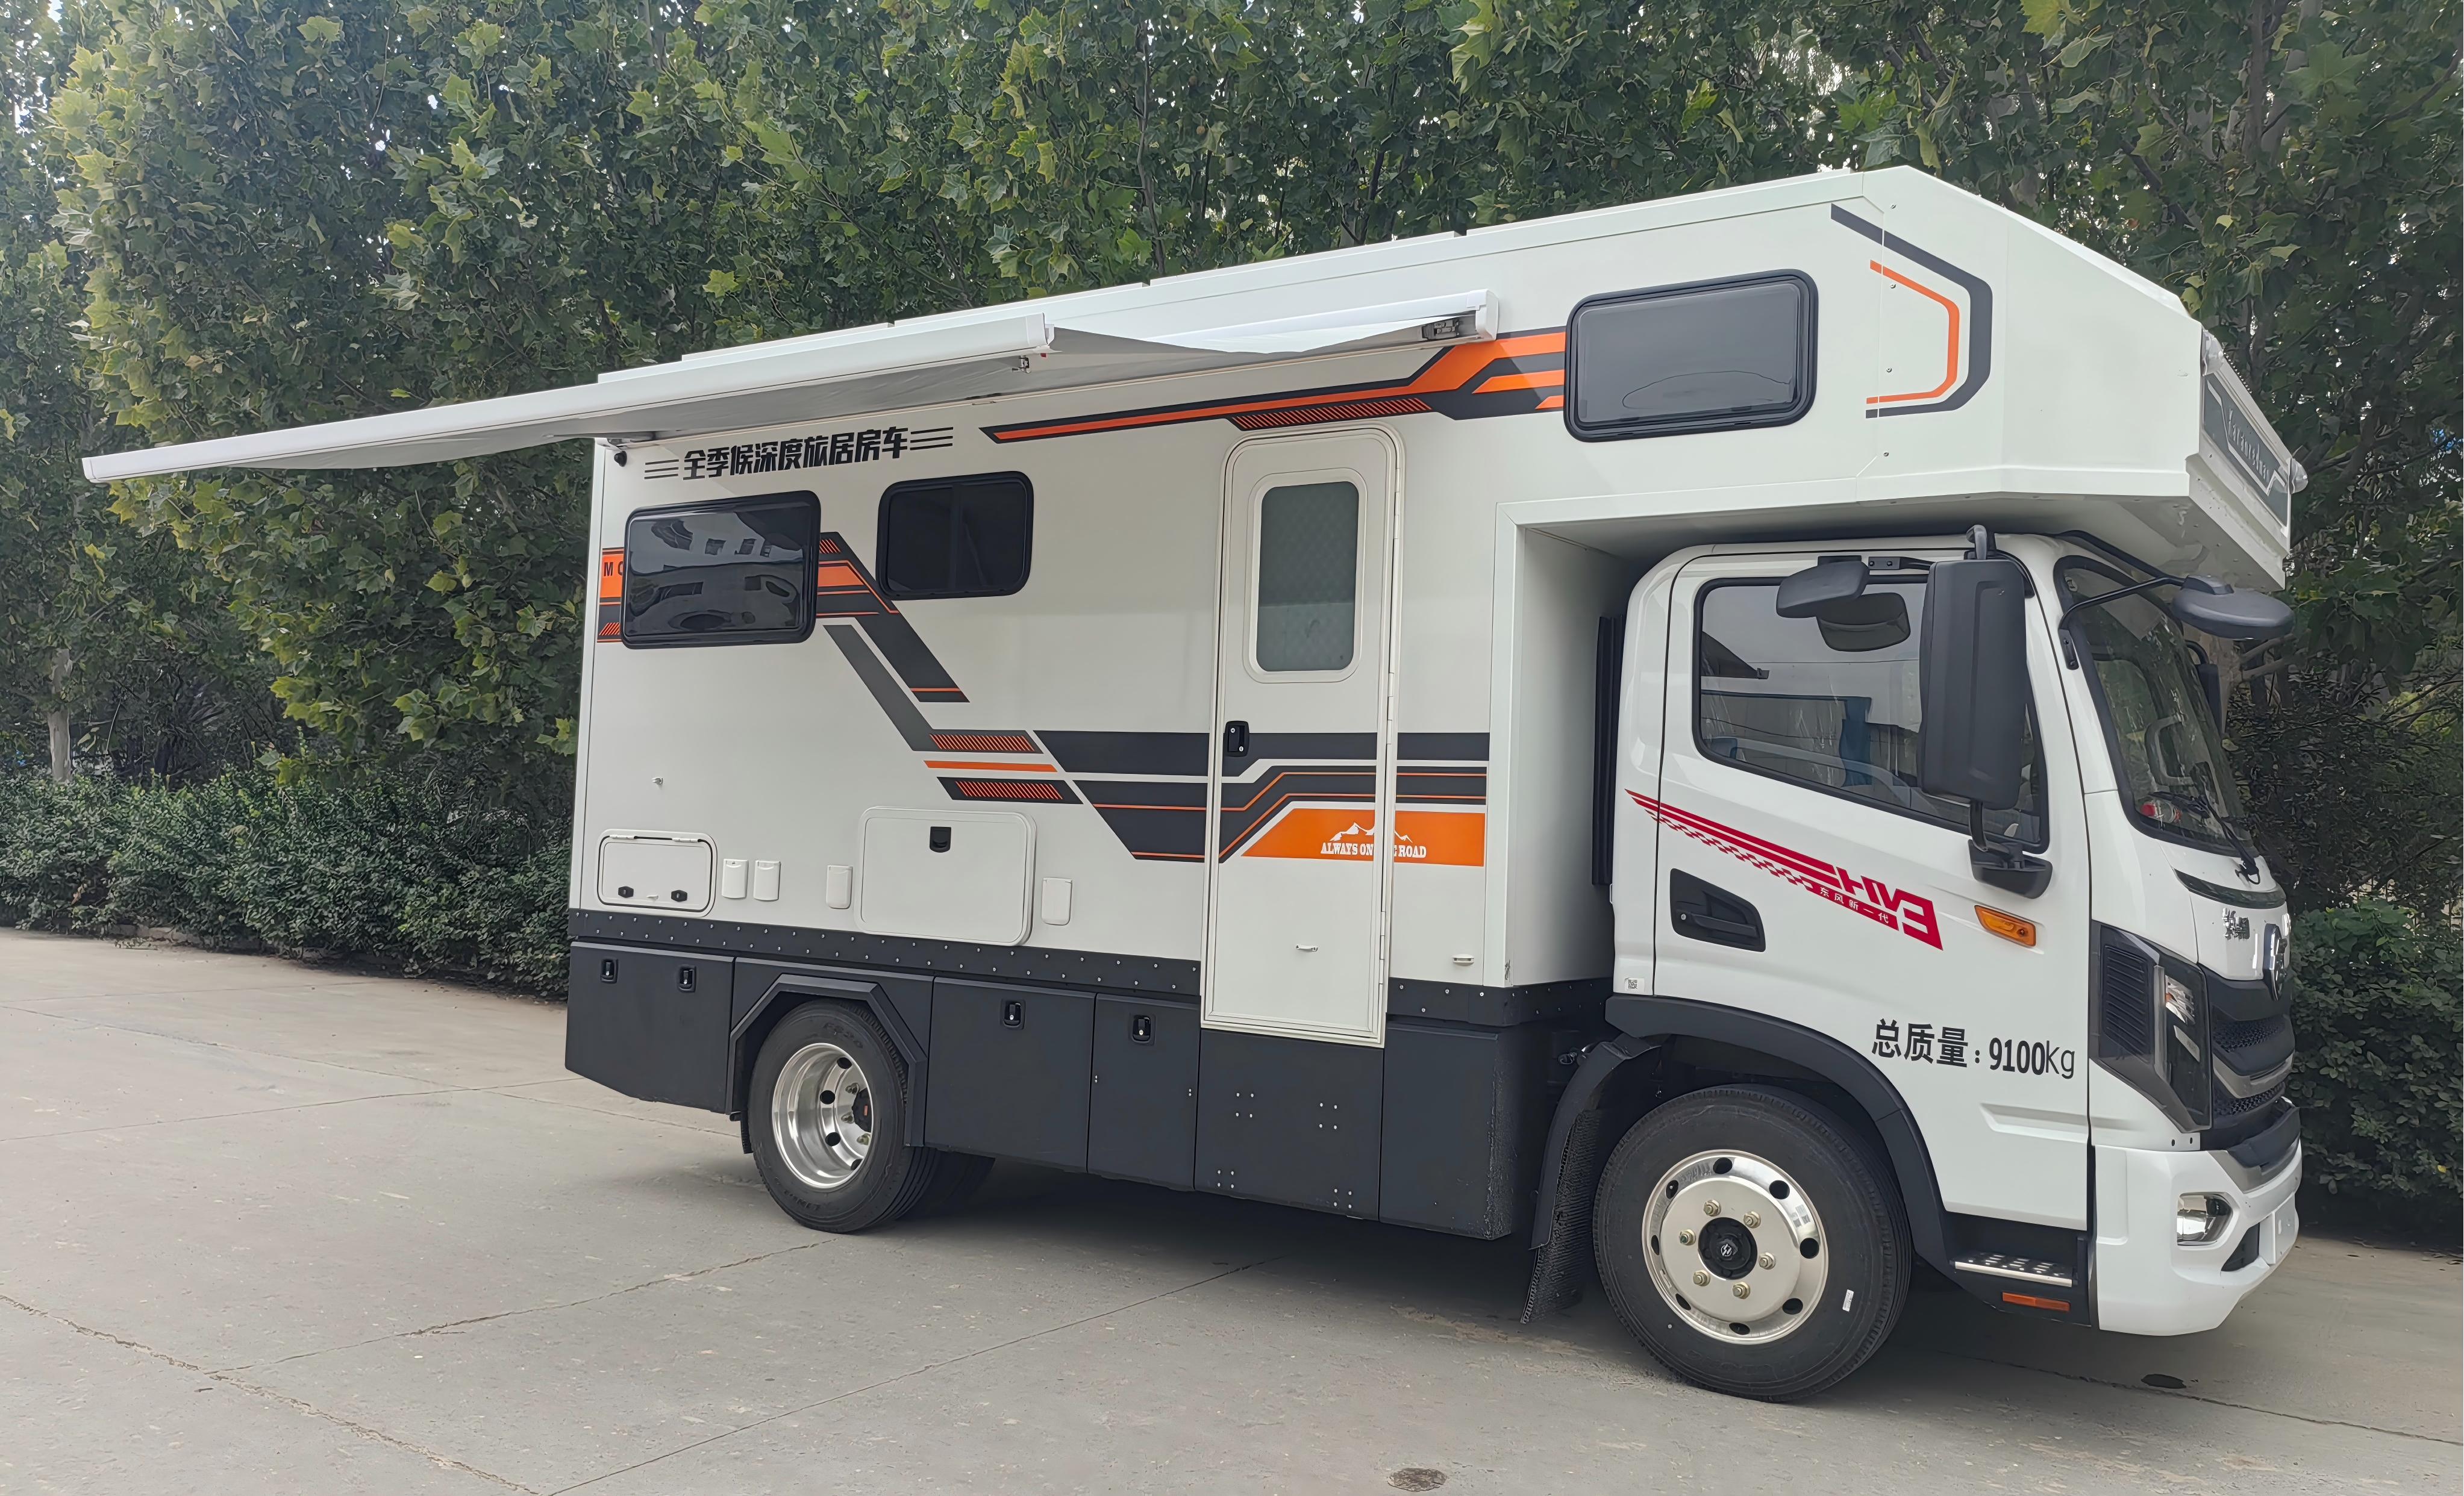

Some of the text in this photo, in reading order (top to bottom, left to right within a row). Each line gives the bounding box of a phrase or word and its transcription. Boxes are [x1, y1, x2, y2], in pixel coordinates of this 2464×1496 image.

[683, 426, 908, 481] 全季候深度旅居房车
[1320, 842, 1359, 855] ALWAYS
[1360, 843, 1374, 856] ON
[1398, 844, 1427, 858] ROAD
[1819, 887, 1889, 924] 东风新一代
